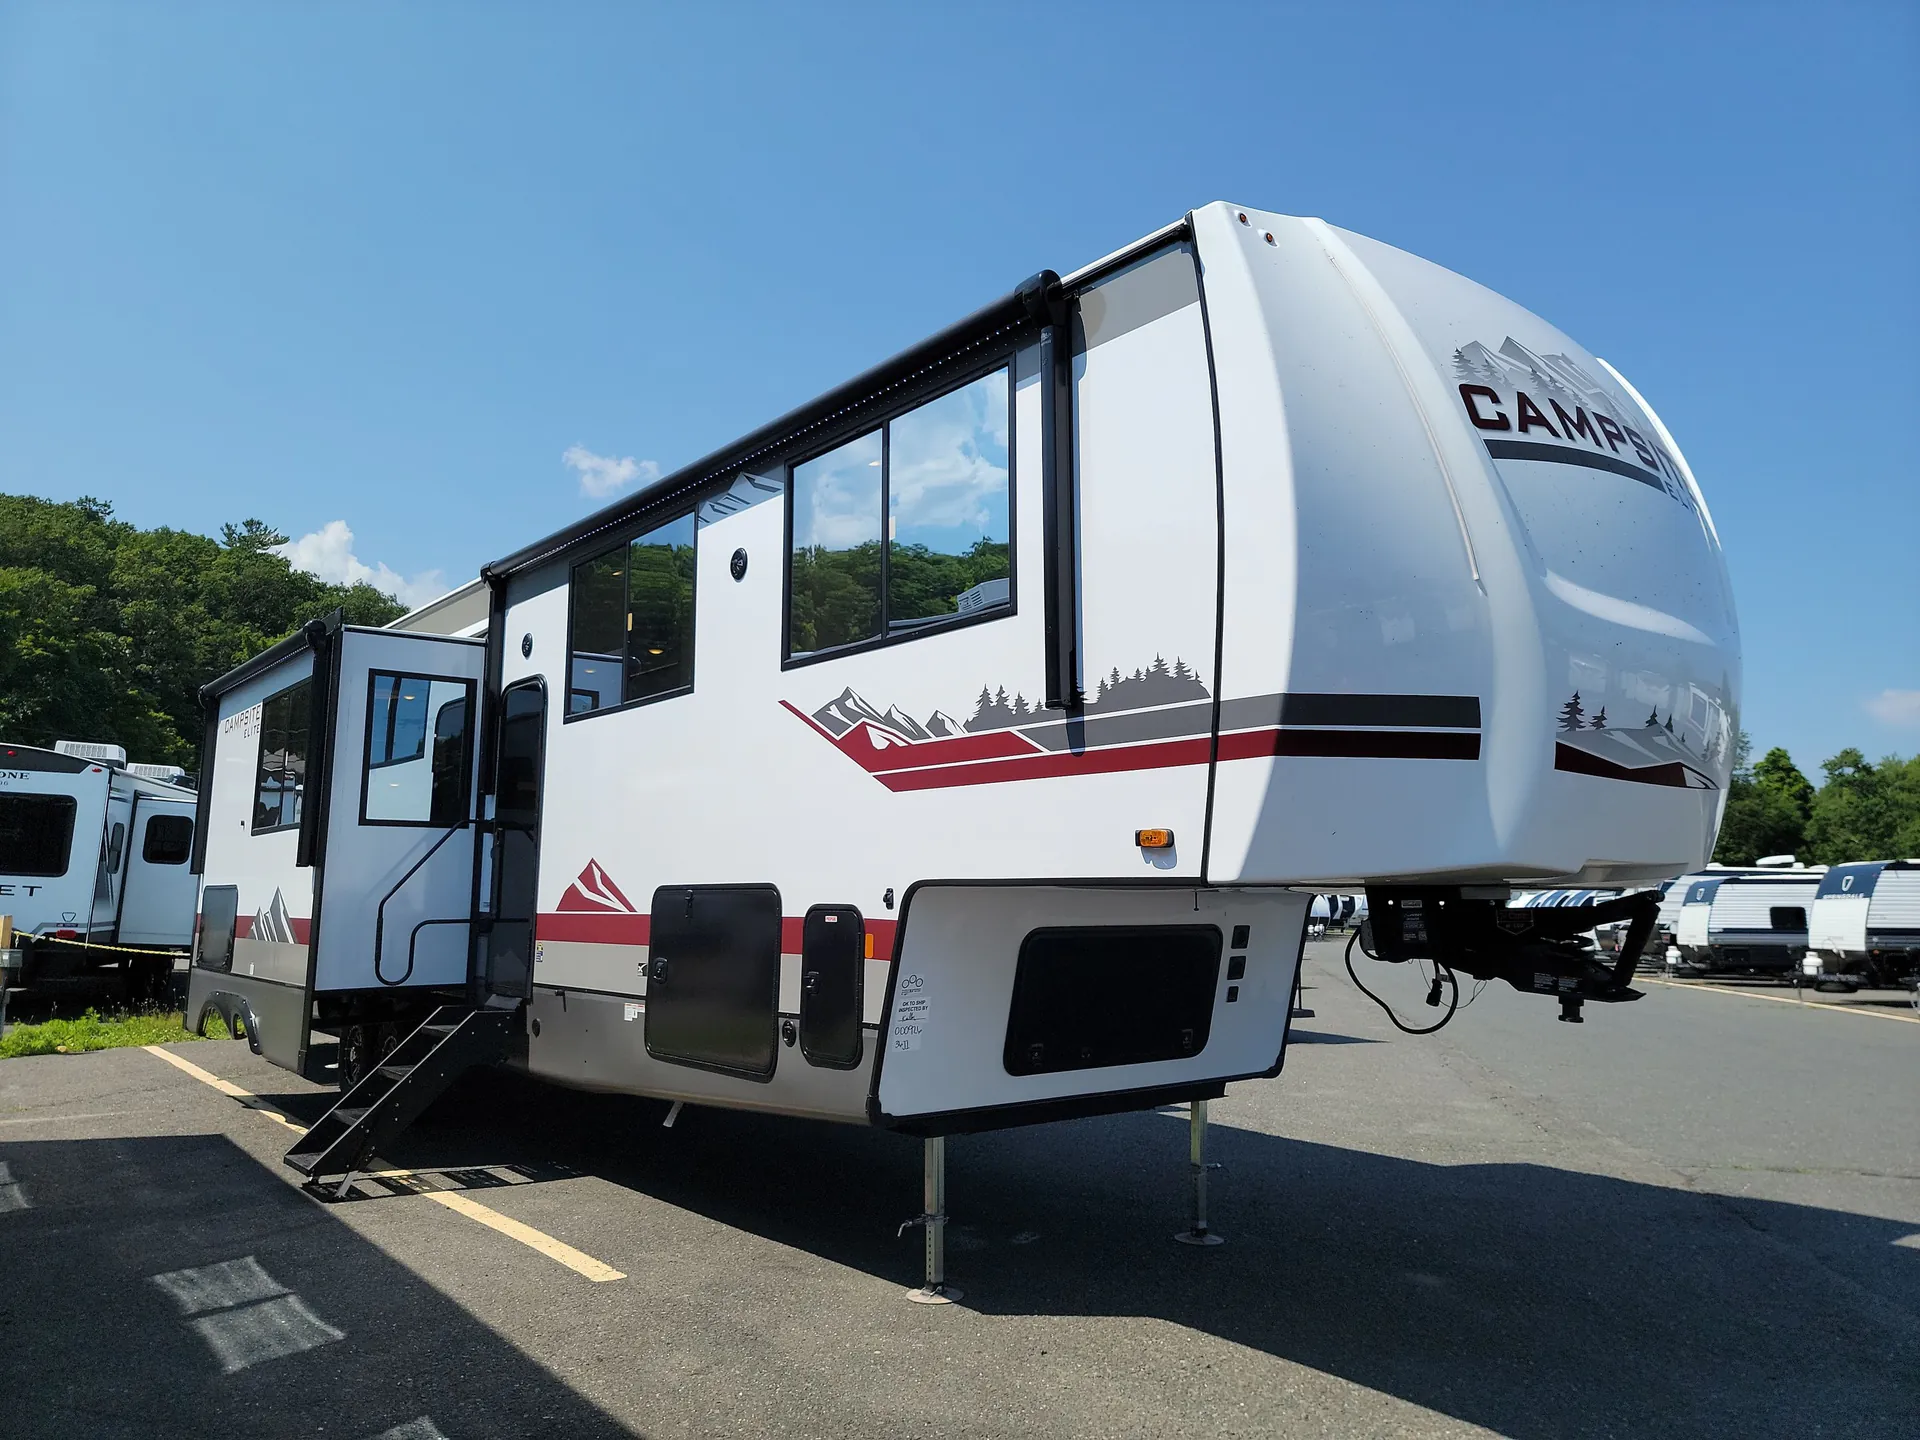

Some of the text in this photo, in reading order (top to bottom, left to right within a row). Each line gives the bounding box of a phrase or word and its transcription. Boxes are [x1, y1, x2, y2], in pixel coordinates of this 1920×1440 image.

[1458, 384, 1686, 490] CAMPSIT
[225, 704, 261, 734] CAMPSITE
[244, 723, 260, 739] ELITE
[0, 885, 43, 897] ET
